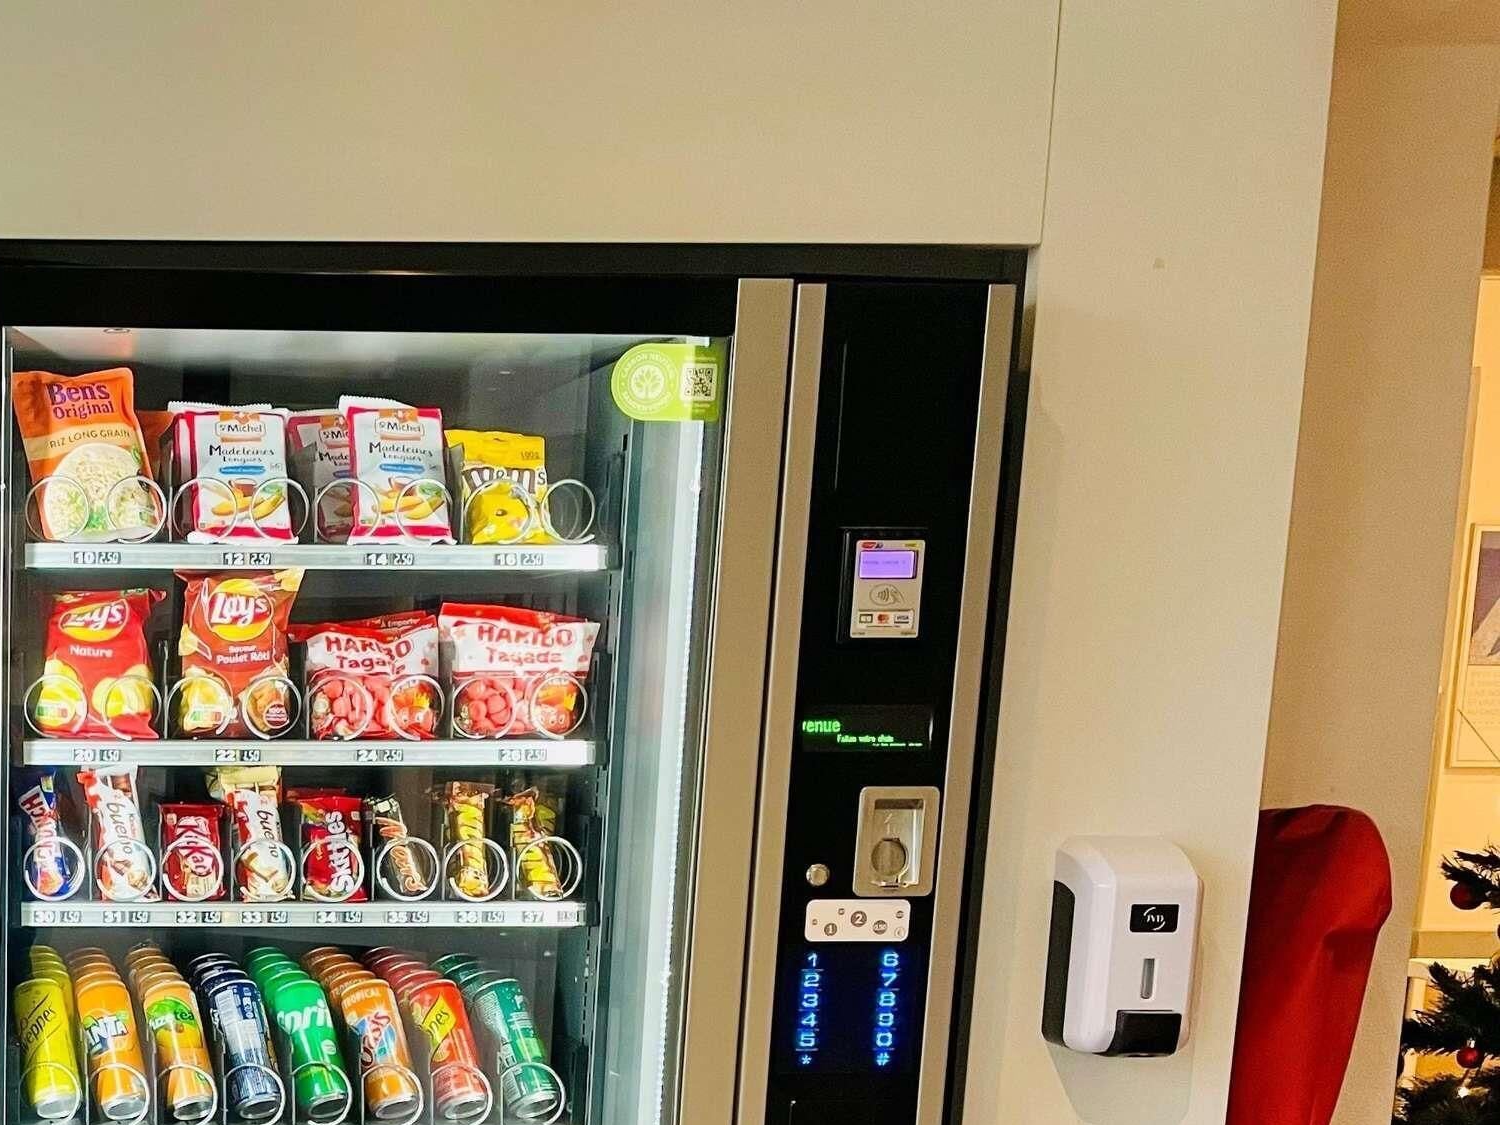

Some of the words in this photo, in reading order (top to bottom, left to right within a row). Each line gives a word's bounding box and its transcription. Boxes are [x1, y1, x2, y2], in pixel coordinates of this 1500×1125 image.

[53, 400, 115, 419] Original
[227, 424, 263, 433] Michel
[387, 422, 421, 432] Michel
[68, 430, 98, 442] LONG
[100, 429, 130, 438] GRAIN
[209, 444, 275, 456] Madeleines
[368, 441, 433, 458] Madeleines
[74, 552, 95, 565] 10
[223, 552, 244, 565] 12
[366, 552, 388, 565] 14
[496, 552, 517, 565] 16
[477, 625, 573, 648] HARIBO
[68, 644, 113, 658] Nature
[324, 635, 411, 661] HARIBO
[216, 653, 248, 664] Poulet
[485, 646, 562, 665] Tagada
[74, 750, 95, 761] 20
[216, 750, 236, 761] 22
[357, 750, 378, 761] 24
[106, 802, 133, 855] bueno
[256, 809, 279, 859] bueno
[175, 823, 215, 876] KitKat
[103, 911, 122, 923] 31
[176, 911, 197, 923] 32
[242, 911, 262, 923] 33
[317, 911, 337, 923] 34
[807, 953, 817, 967] 1
[883, 952, 899, 967] 6
[803, 973, 820, 987] 2
[880, 972, 898, 987] 7
[343, 987, 380, 1009] TROPICAL
[801, 993, 819, 1007] 3
[879, 993, 896, 1007] 8
[173, 1008, 195, 1021] tea
[801, 1013, 817, 1027] 4
[878, 1012, 894, 1026] 9
[799, 1032, 816, 1047] 5
[876, 1032, 893, 1047] 0
